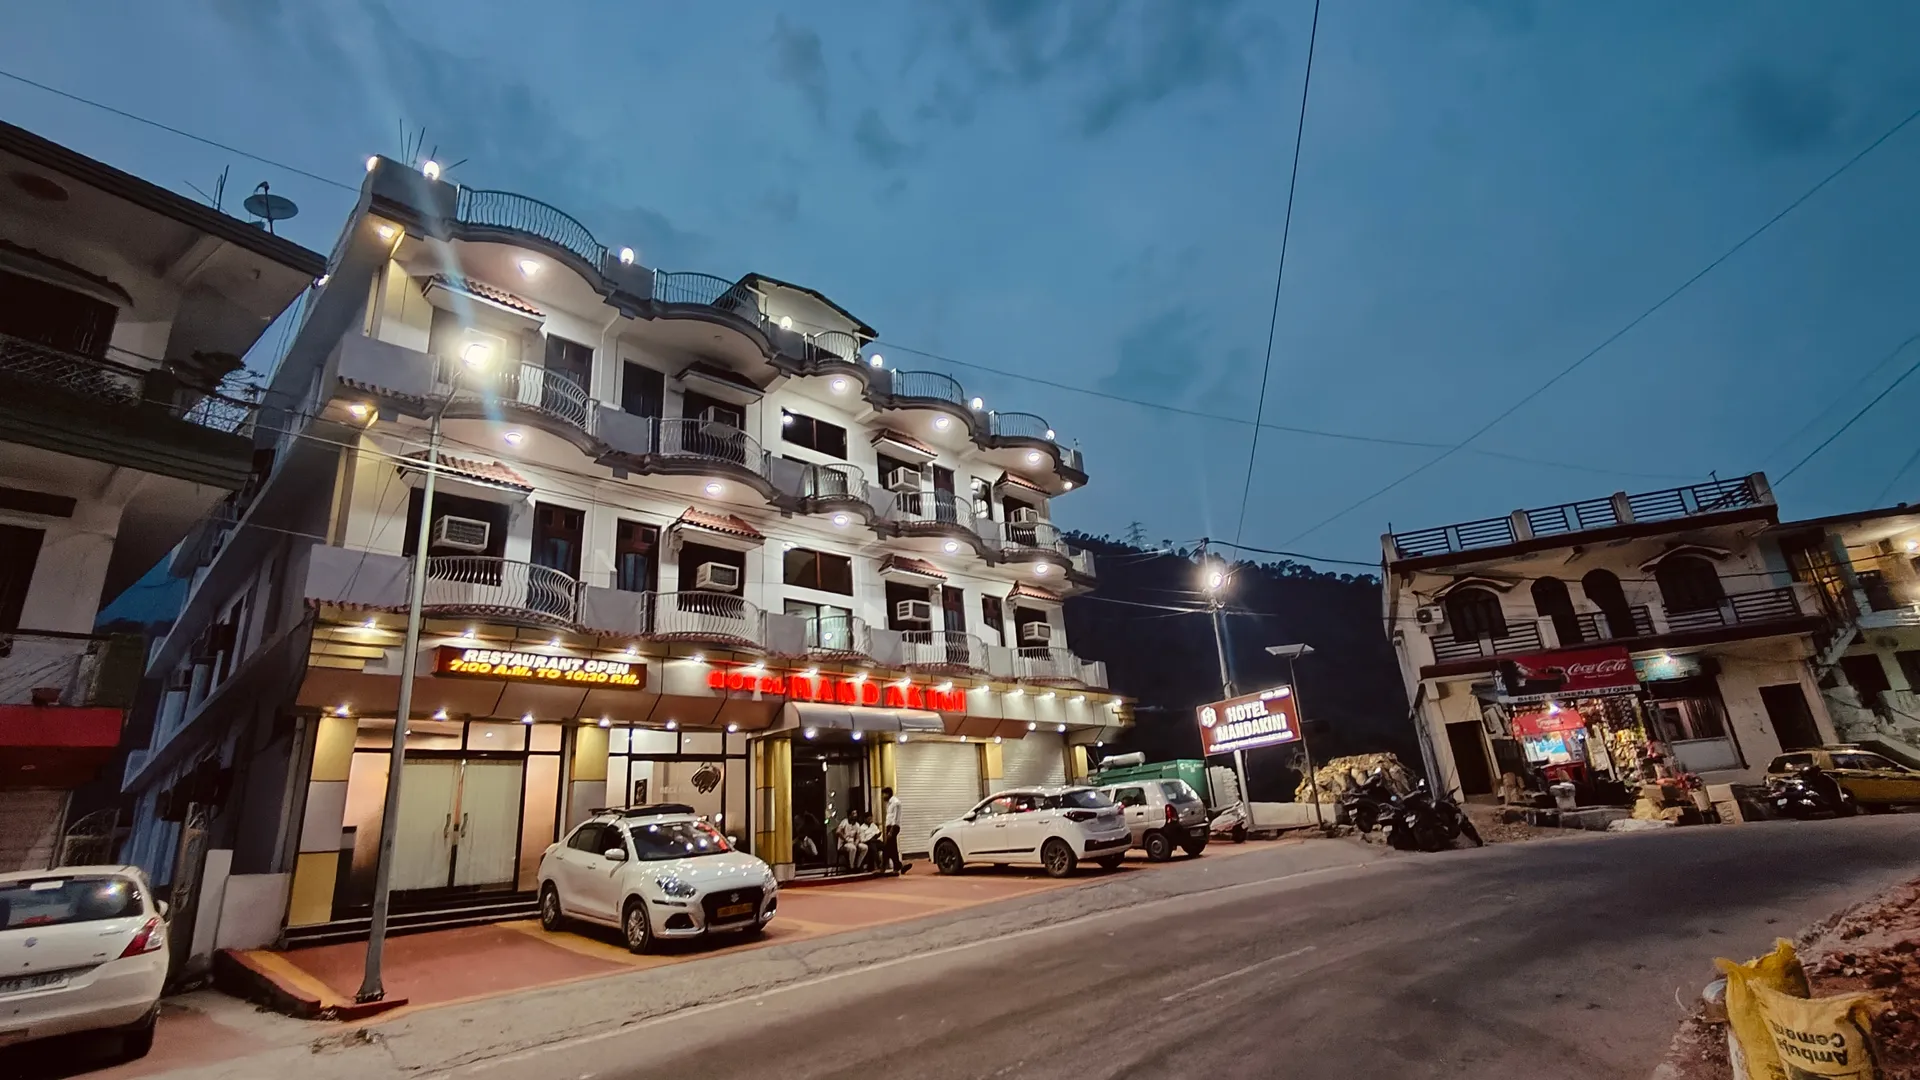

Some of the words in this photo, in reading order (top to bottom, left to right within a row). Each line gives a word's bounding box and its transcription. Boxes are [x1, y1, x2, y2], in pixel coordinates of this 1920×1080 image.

[449, 659, 490, 673] 7:00
[492, 664, 533, 677] A.M.
[537, 668, 562, 679] TO
[564, 670, 609, 682] 10:30
[464, 649, 584, 669] RESTAURANT
[583, 661, 630, 675] OPEN
[1567, 659, 1627, 675] Coca-Cola
[707, 669, 787, 694] HOTEL
[1599, 686, 1634, 695] STORE
[1225, 701, 1269, 722] HOTEL
[1215, 713, 1287, 742] MANDAKINI
